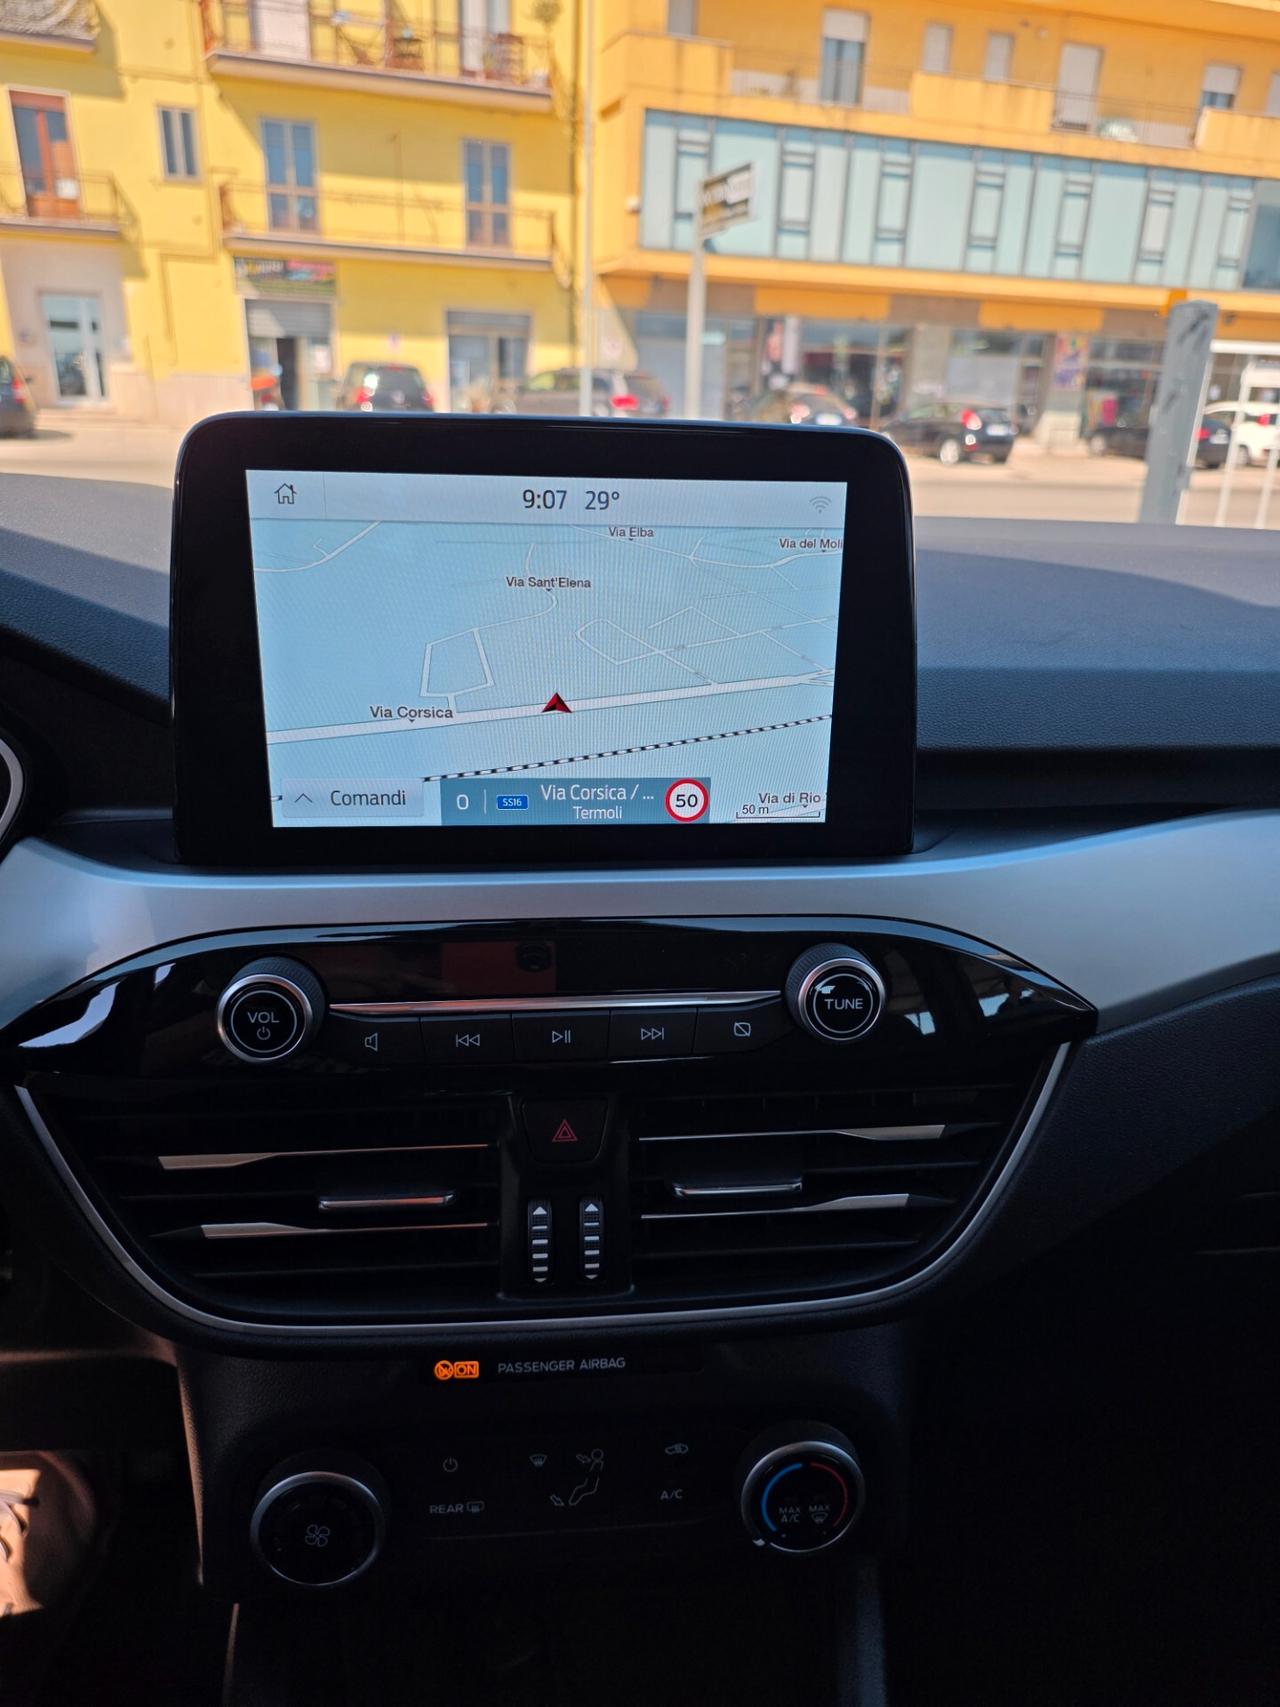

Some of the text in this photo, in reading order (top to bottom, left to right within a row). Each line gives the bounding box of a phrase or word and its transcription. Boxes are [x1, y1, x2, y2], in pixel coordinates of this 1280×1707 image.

[523, 489, 620, 510] 9:07 29°
[608, 526, 654, 537] Via Elba
[779, 538, 796, 548] Via
[799, 538, 816, 548] del
[506, 576, 591, 588] Via Sant'Elena
[370, 705, 453, 719] Via Corsica
[330, 790, 406, 806] Comandi
[540, 784, 566, 800] Via
[570, 783, 626, 801] Corsica
[630, 783, 640, 800] /
[758, 792, 821, 804] Via di Rio
[502, 797, 522, 807] SS16
[675, 793, 698, 808] 50
[573, 805, 622, 820] Termoli
[742, 804, 769, 815] 50 m
[824, 998, 863, 1010] TUNE
[248, 1011, 280, 1024] VOL
[456, 1364, 476, 1376] ON
[498, 1357, 626, 1374] PASSENGER AIRBAG
[660, 1489, 684, 1501] A/C
[430, 1503, 464, 1515] REAR
[778, 1505, 801, 1515] MAX
[808, 1504, 831, 1513] MAX
[781, 1514, 800, 1523] A/C
